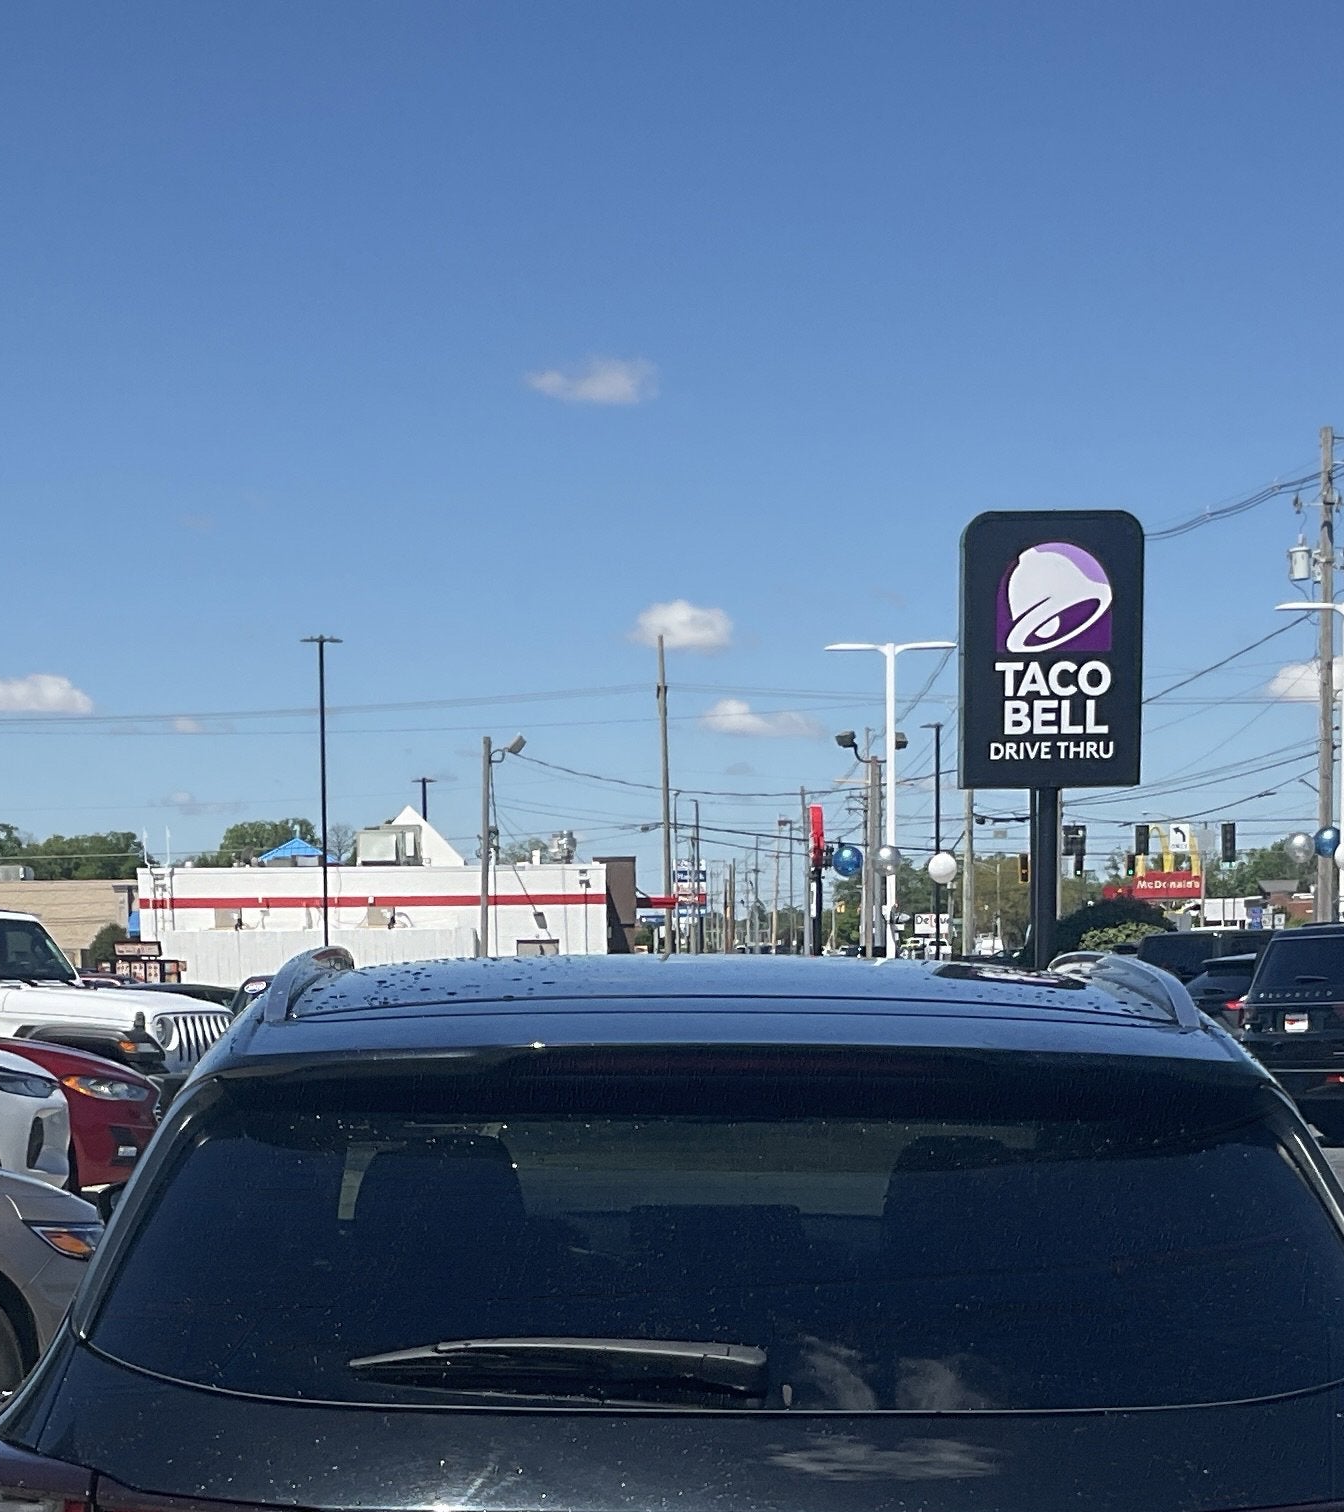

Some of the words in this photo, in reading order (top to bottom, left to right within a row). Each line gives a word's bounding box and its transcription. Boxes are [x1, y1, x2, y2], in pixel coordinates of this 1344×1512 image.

[995, 660, 1111, 697] TACO
[1004, 700, 1109, 735] BELL
[990, 742, 1051, 760] DRIVE
[1057, 741, 1114, 759] THRU
